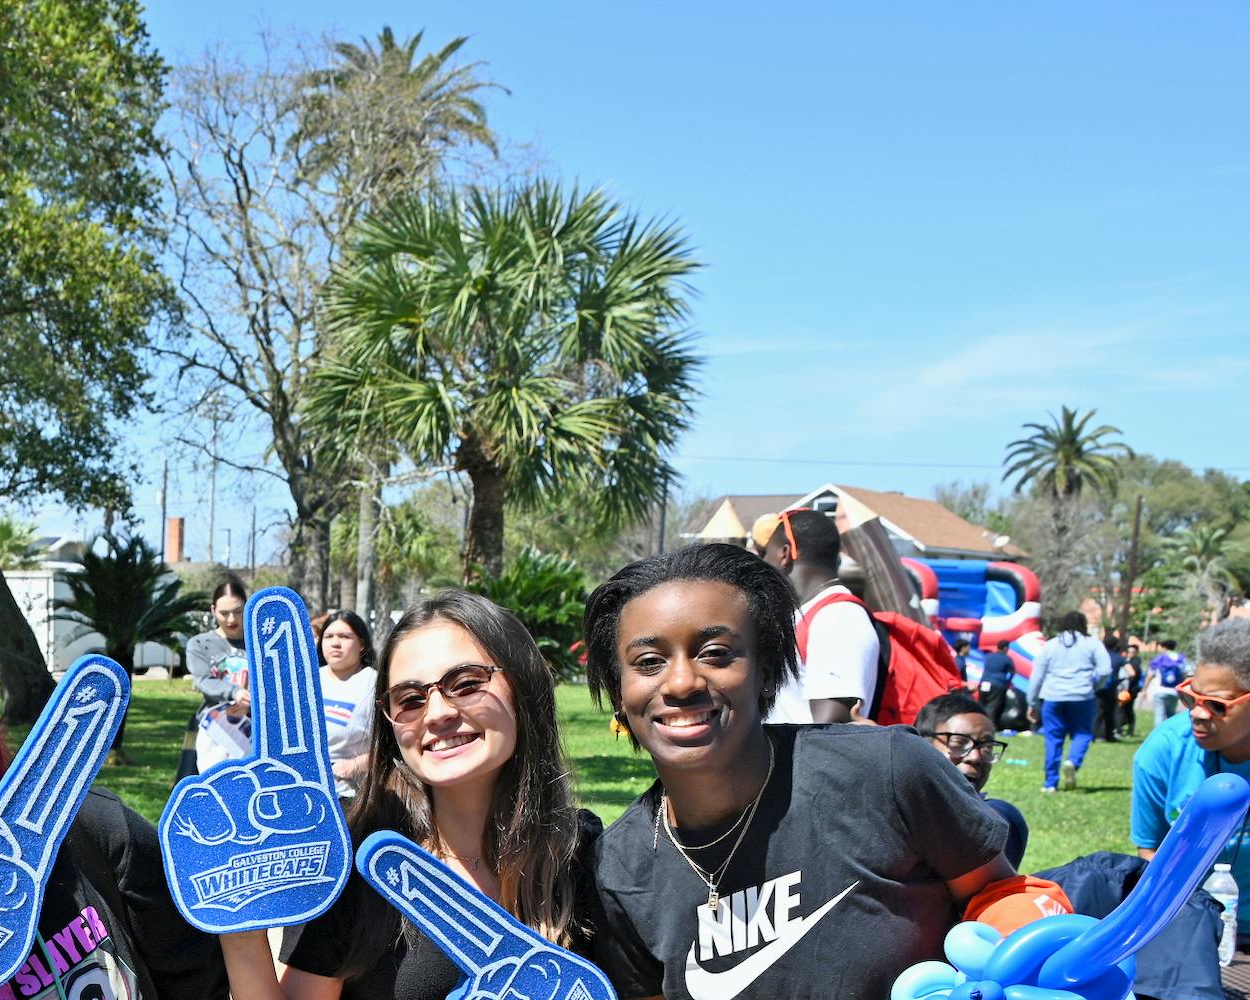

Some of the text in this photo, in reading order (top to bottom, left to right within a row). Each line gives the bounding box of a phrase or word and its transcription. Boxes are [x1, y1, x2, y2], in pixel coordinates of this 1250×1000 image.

[261, 617, 309, 755] #1
[14, 686, 109, 835] #1
[198, 858, 322, 900] WHITECAPS
[232, 845, 326, 868] GALVESTON COLLEGE
[15, 905, 108, 997] SLAYER
[386, 859, 504, 958] #1
[696, 870, 803, 962] NIKE
